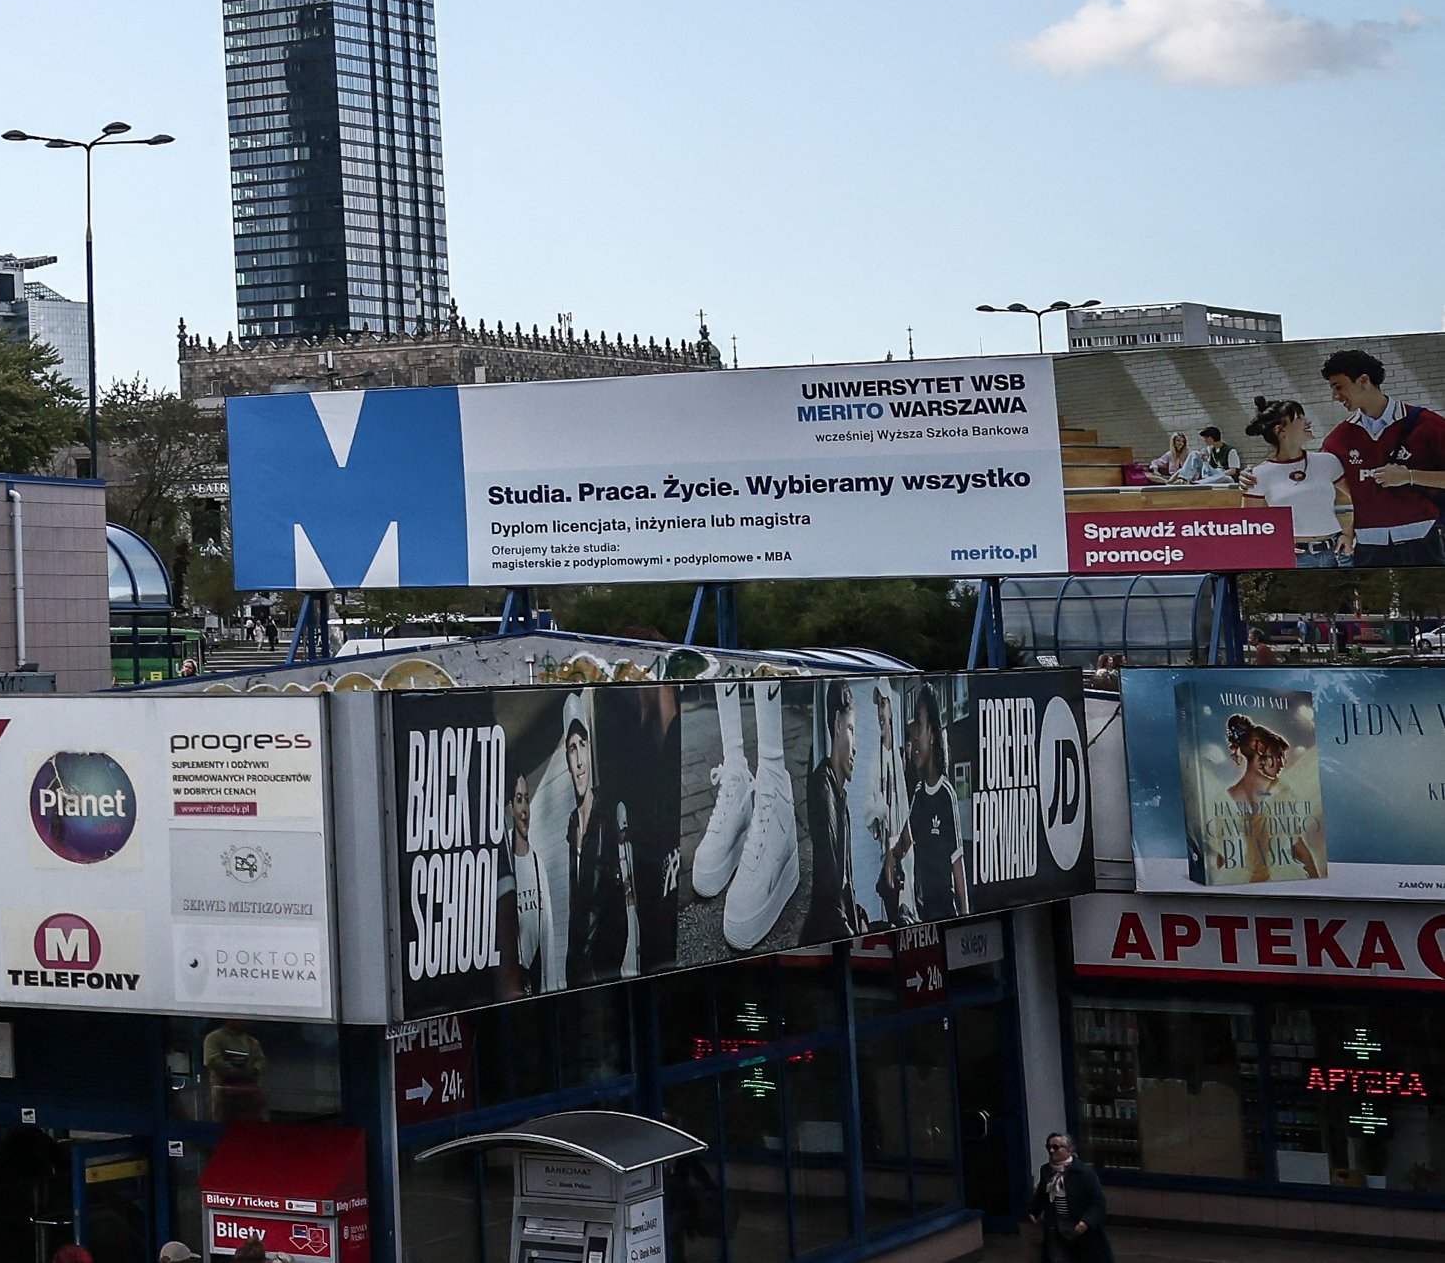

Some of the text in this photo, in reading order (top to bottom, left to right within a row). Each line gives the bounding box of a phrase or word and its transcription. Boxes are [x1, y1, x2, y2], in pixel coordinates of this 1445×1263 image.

[802, 374, 1025, 400] UNIWERSYTET WSB
[797, 396, 1027, 422] MERITO WARSZAWA
[816, 425, 1029, 442] wcześniej Wyższa Szkoła Bankowa
[489, 467, 1031, 505] Studia. Praca. Życie. Wybieramy wszystko
[491, 513, 811, 537] Dyplom licencjata, inżyniera lub magistra
[1084, 520, 1275, 542] Sprawdź aktualne
[492, 542, 620, 556] Oferujemy także studia:
[951, 544, 1037, 562] merito.pl
[1086, 547, 1184, 566] promocje
[492, 558, 561, 570] magisterskie
[573, 555, 663, 569] podyplomowymi
[674, 554, 753, 566] podyplomowe
[765, 551, 792, 562] MBA
[1336, 703, 1424, 745] JEDNA
[170, 734, 312, 753] progress
[978, 697, 1038, 790] FOREVER
[172, 761, 225, 769] SUPLEMENTY
[231, 759, 269, 769] ODŻYWKI
[172, 773, 311, 782] RENOMOWANYCH PRODUCENTÓW
[1047, 738, 1080, 829] JD
[223, 788, 256, 796] CENACH
[406, 725, 506, 853] BACK TO
[39, 789, 126, 818] Planet
[181, 804, 250, 814] www.ultrabody.pl
[972, 787, 1038, 885] FORWARD
[183, 899, 313, 916] SERWIS MISTRZOWSKI
[409, 848, 501, 981] SCHOOL
[45, 927, 90, 962] M
[899, 925, 939, 952] APTEKA
[1111, 912, 1405, 970] APTEKA
[217, 950, 315, 966] DOKTOR
[7, 970, 141, 990] TELEFONY
[217, 968, 316, 981] MARCHEWKA
[927, 966, 943, 991] 24h
[396, 1016, 462, 1053] APTEKA
[1307, 1068, 1427, 1096] APTEKA
[545, 1166, 591, 1176] BANKOMAT
[207, 1194, 236, 1206] Bilety
[243, 1197, 279, 1208] Tickets
[216, 1222, 266, 1240] Bilety
